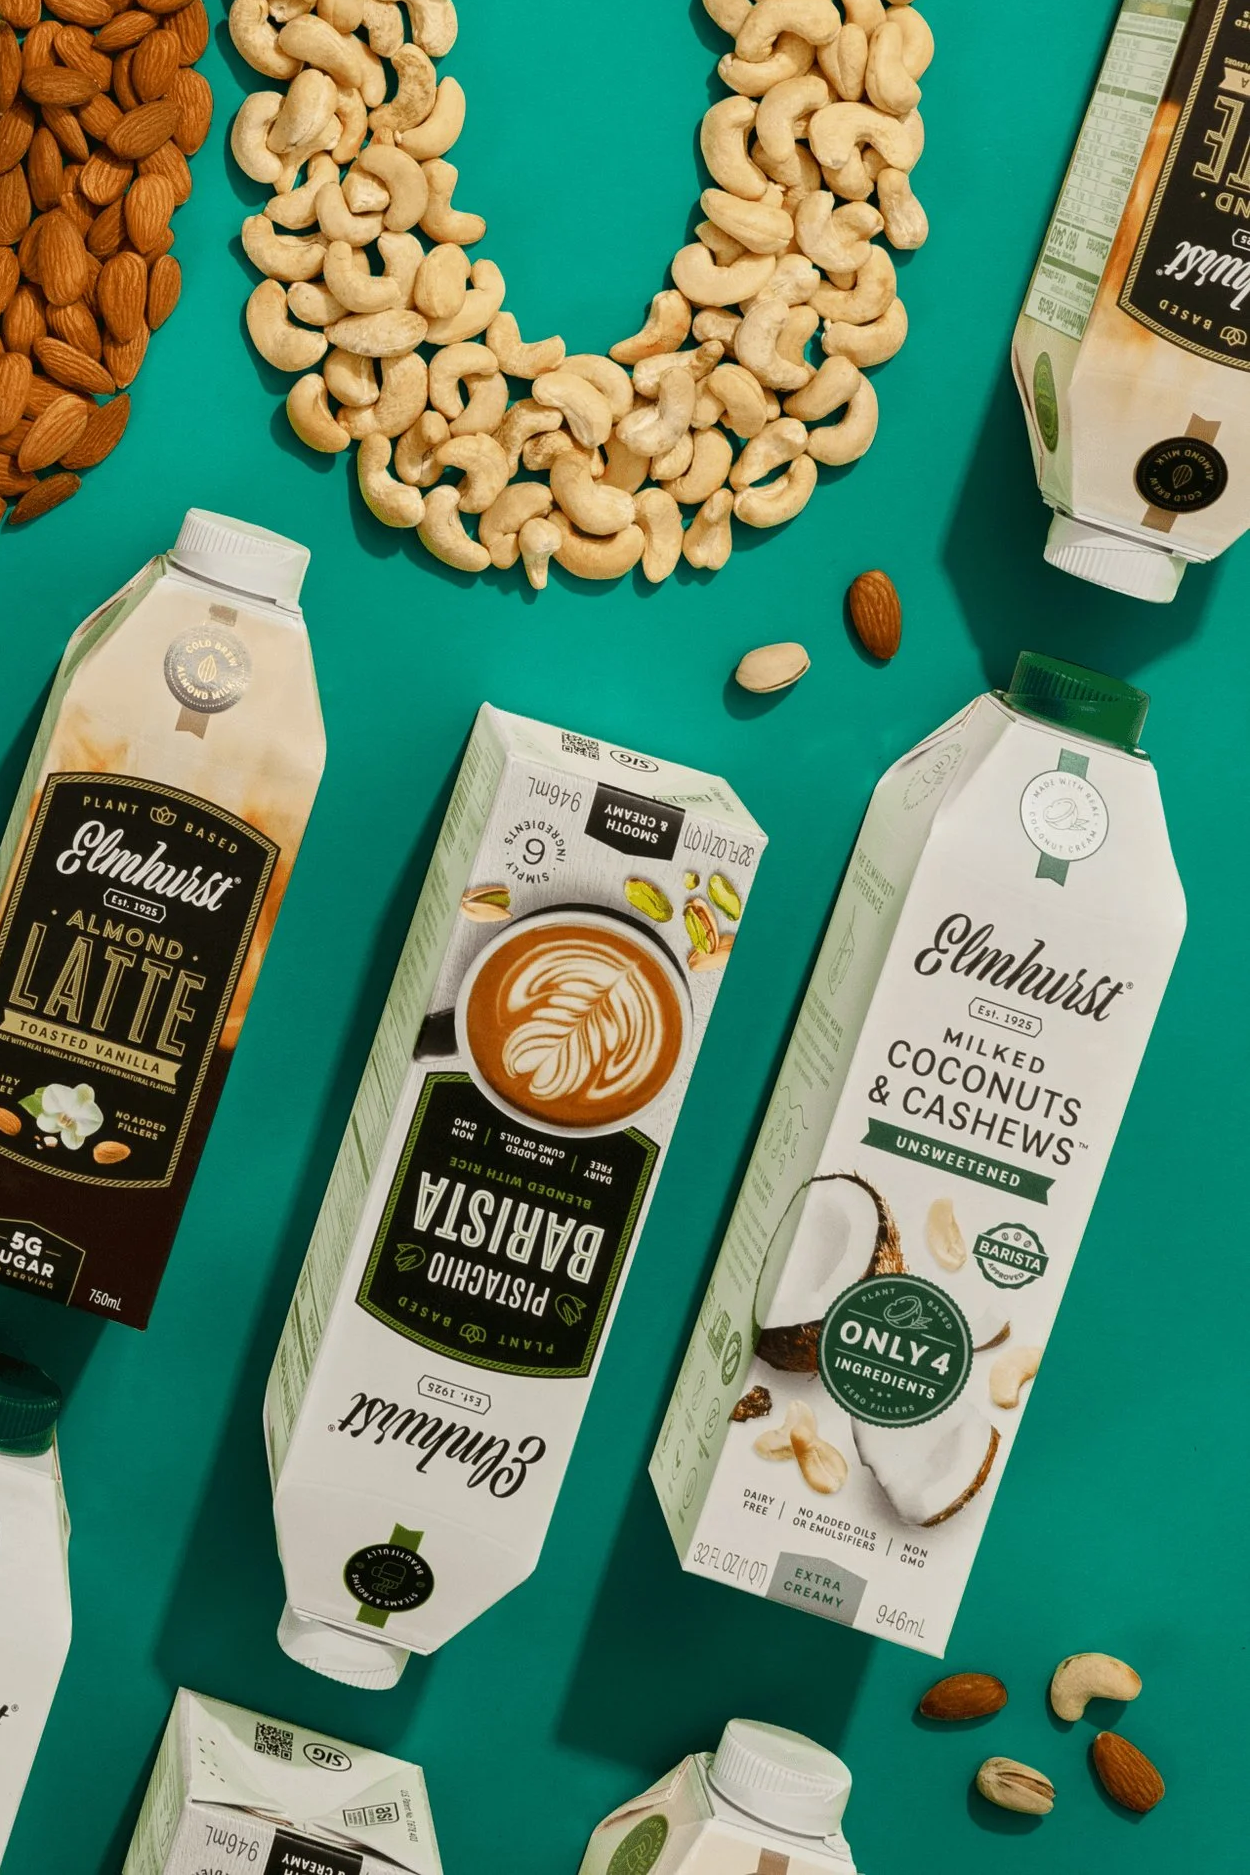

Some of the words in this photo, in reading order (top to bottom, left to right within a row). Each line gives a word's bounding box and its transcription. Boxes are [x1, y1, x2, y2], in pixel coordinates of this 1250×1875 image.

[1158, 299, 1212, 329] BASED
[529, 777, 583, 812] 946mL
[65, 910, 184, 959] ALMOND
[8, 922, 206, 1057] LATTE
[976, 1004, 1000, 1019] Est.
[1003, 1013, 1033, 1030] 1925
[942, 1027, 1045, 1074] MILKED
[868, 1076, 890, 1105] &
[887, 1040, 1082, 1125] COCONUTS
[115, 1110, 131, 1121] NO
[131, 1115, 166, 1133] ADDED
[117, 1121, 158, 1140] FILLERS
[895, 1135, 1021, 1187] UNSWEETENED
[9, 1230, 43, 1257] 5G
[413, 1171, 605, 1284] BARISTA
[979, 1240, 1039, 1271] BARISTA
[5, 1268, 54, 1290] SERVING
[426, 1252, 551, 1317] PISTACHIO
[88, 1289, 120, 1311] 750mL
[839, 1320, 930, 1364] ONLY
[930, 1353, 951, 1375] 4
[834, 1356, 936, 1399] INGREDIENTS
[874, 1604, 923, 1639] 946mL
[205, 1825, 260, 1862] 946mL
